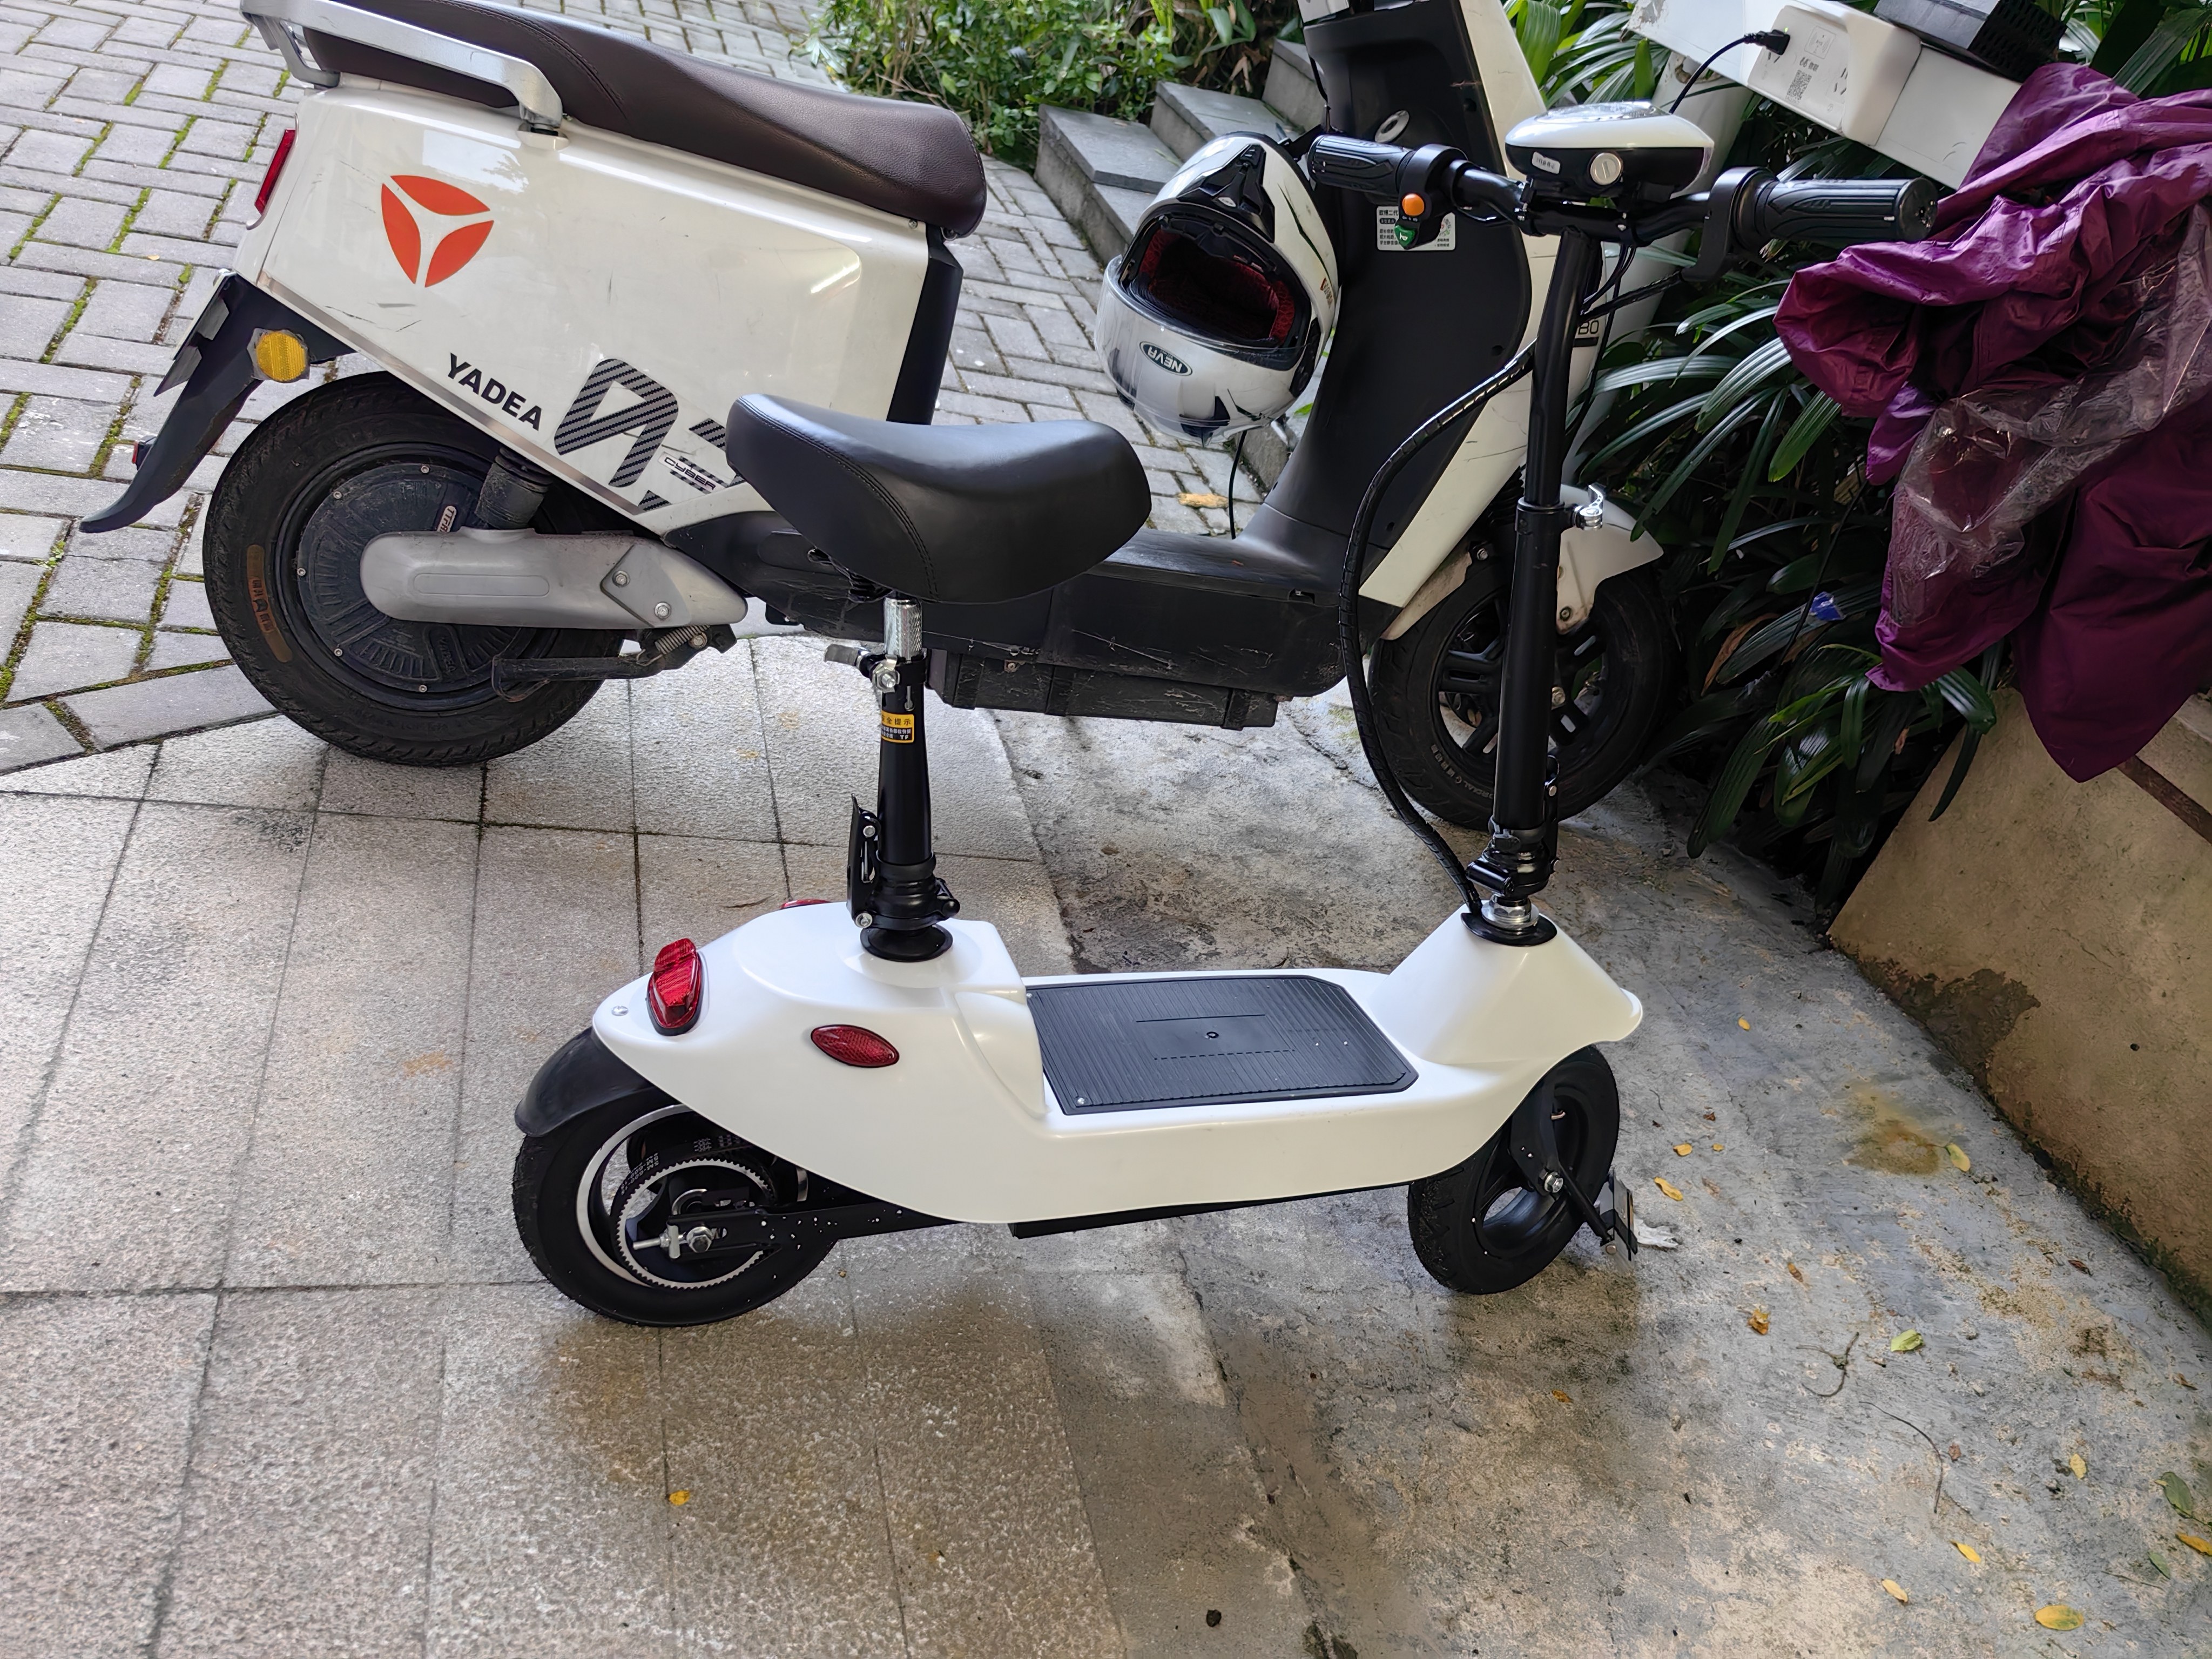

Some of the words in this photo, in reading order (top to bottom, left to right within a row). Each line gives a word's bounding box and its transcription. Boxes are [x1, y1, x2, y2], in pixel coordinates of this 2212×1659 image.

[1148, 346, 1182, 373] NEVA
[448, 353, 543, 432] YADEA
[664, 456, 716, 490] CYBER
[440, 508, 455, 532] TTFA
